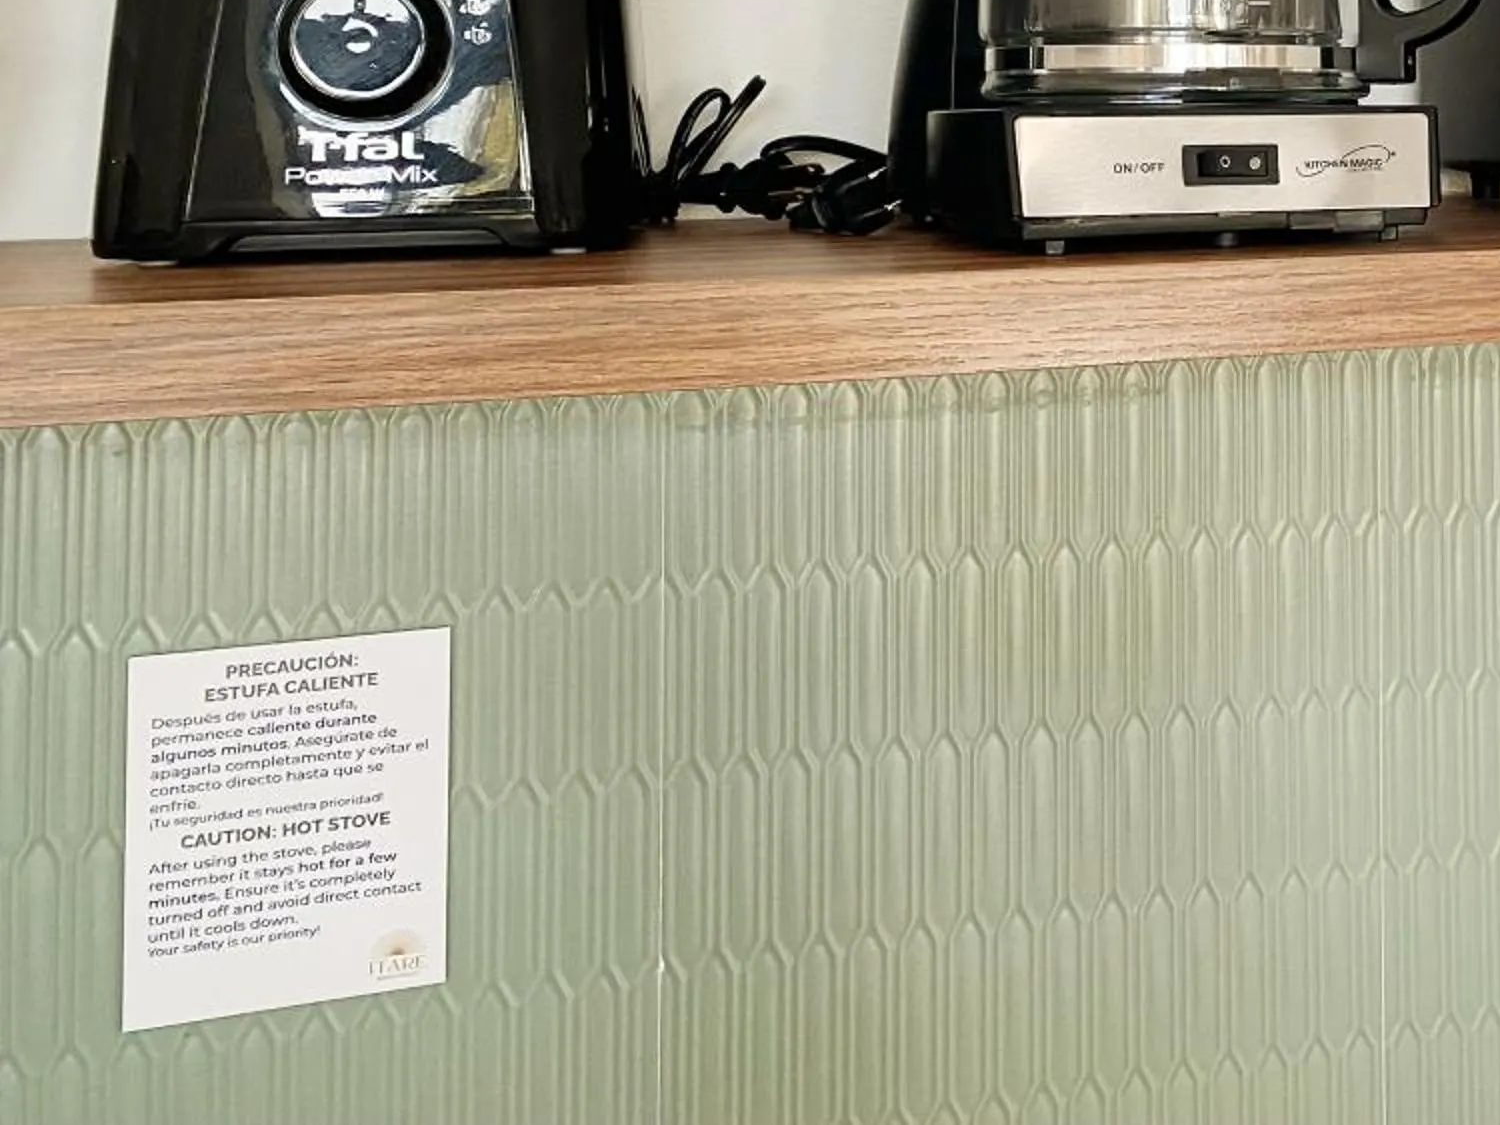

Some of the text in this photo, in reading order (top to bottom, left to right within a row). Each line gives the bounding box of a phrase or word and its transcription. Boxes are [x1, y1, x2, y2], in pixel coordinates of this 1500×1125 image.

[226, 651, 360, 679] PRECAUCIÓN:
[205, 672, 379, 702] ESTUFA CALIENTE
[151, 698, 358, 730] Después de usar la estufa,
[151, 714, 377, 749] permanece caliente durante
[150, 738, 429, 781] apagarla completamente y evitar el
[151, 748, 217, 765] algunos
[221, 739, 291, 756] minutos.
[378, 726, 398, 738] de
[149, 762, 384, 798] contacto directo hasta que se
[174, 808, 244, 827] seguridad
[247, 807, 263, 818] es
[266, 800, 317, 816] nuestra
[181, 810, 391, 849] CAUTION: HOT STOVE
[149, 840, 372, 875] After using the stove, please
[149, 852, 397, 892] remember it stays hot for a few
[148, 881, 422, 926] turned off and avoid direct contact
[149, 868, 397, 910] minutes. Ensure it's completely
[147, 915, 299, 944] until it cools down.
[183, 939, 224, 954] safety
[228, 937, 240, 948] is
[242, 933, 265, 946] our
